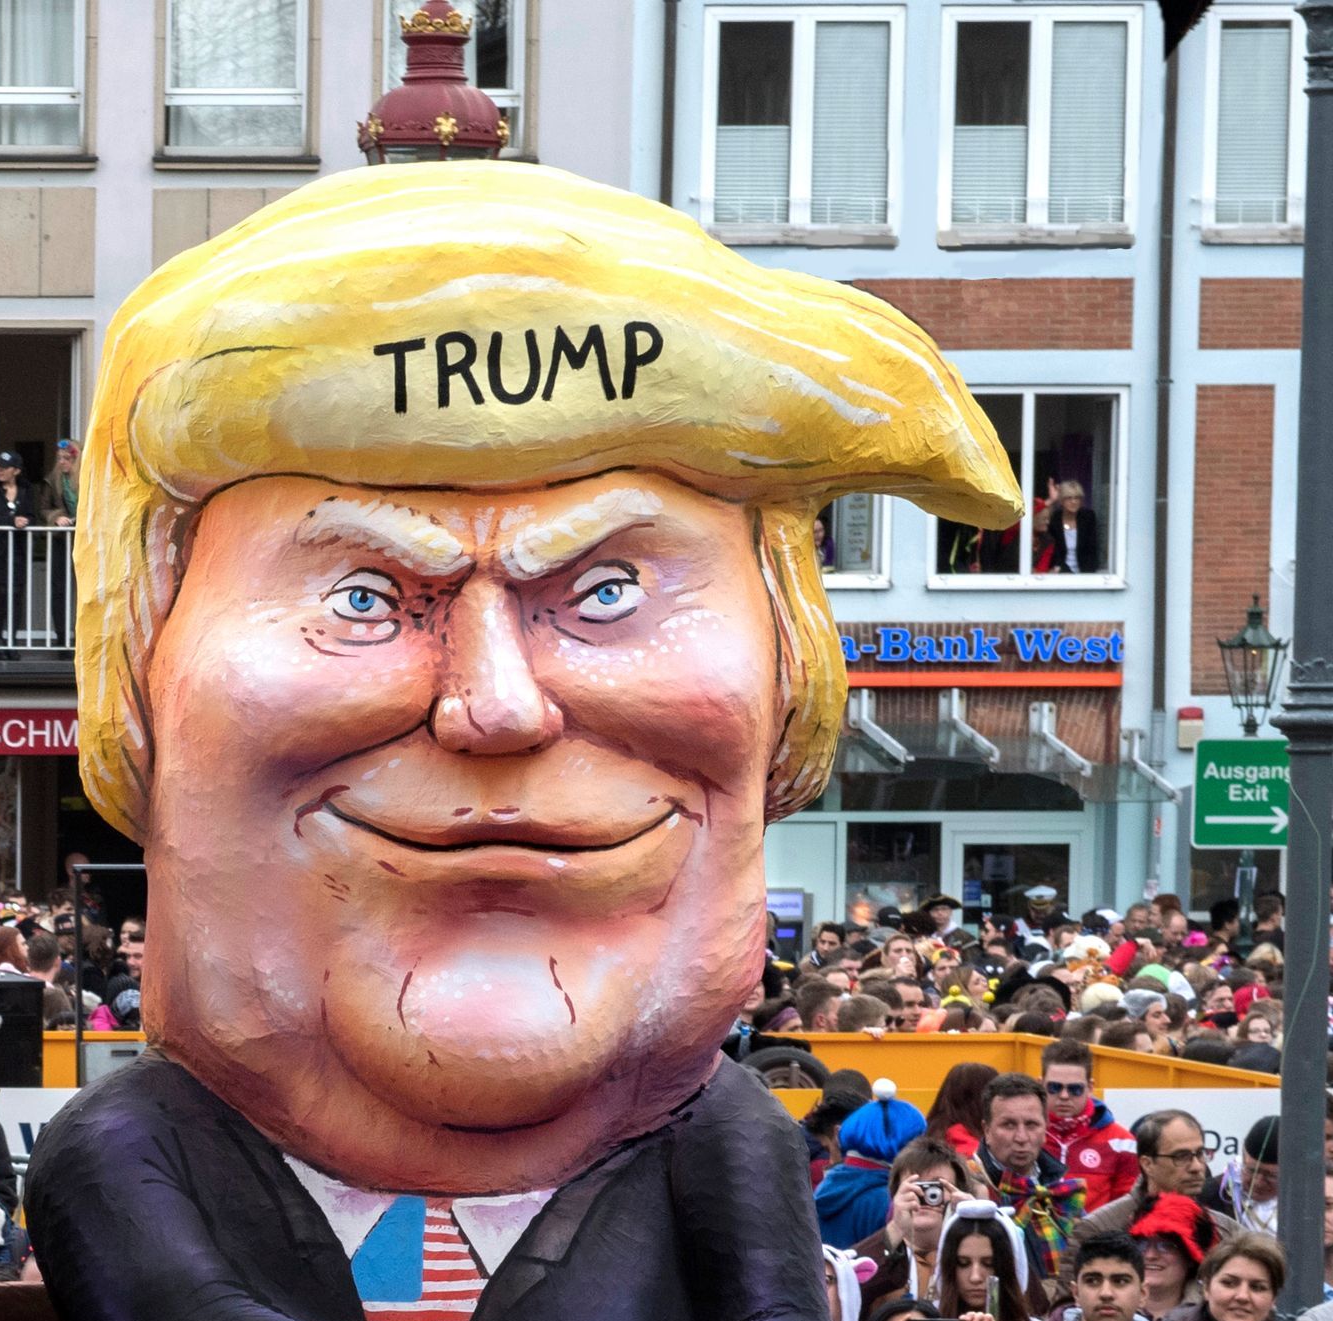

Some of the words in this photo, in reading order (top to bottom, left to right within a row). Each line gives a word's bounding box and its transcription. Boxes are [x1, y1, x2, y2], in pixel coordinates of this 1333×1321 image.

[373, 321, 664, 417] TRUMP
[1012, 628, 1124, 663] West
[1228, 783, 1269, 802] Exit
